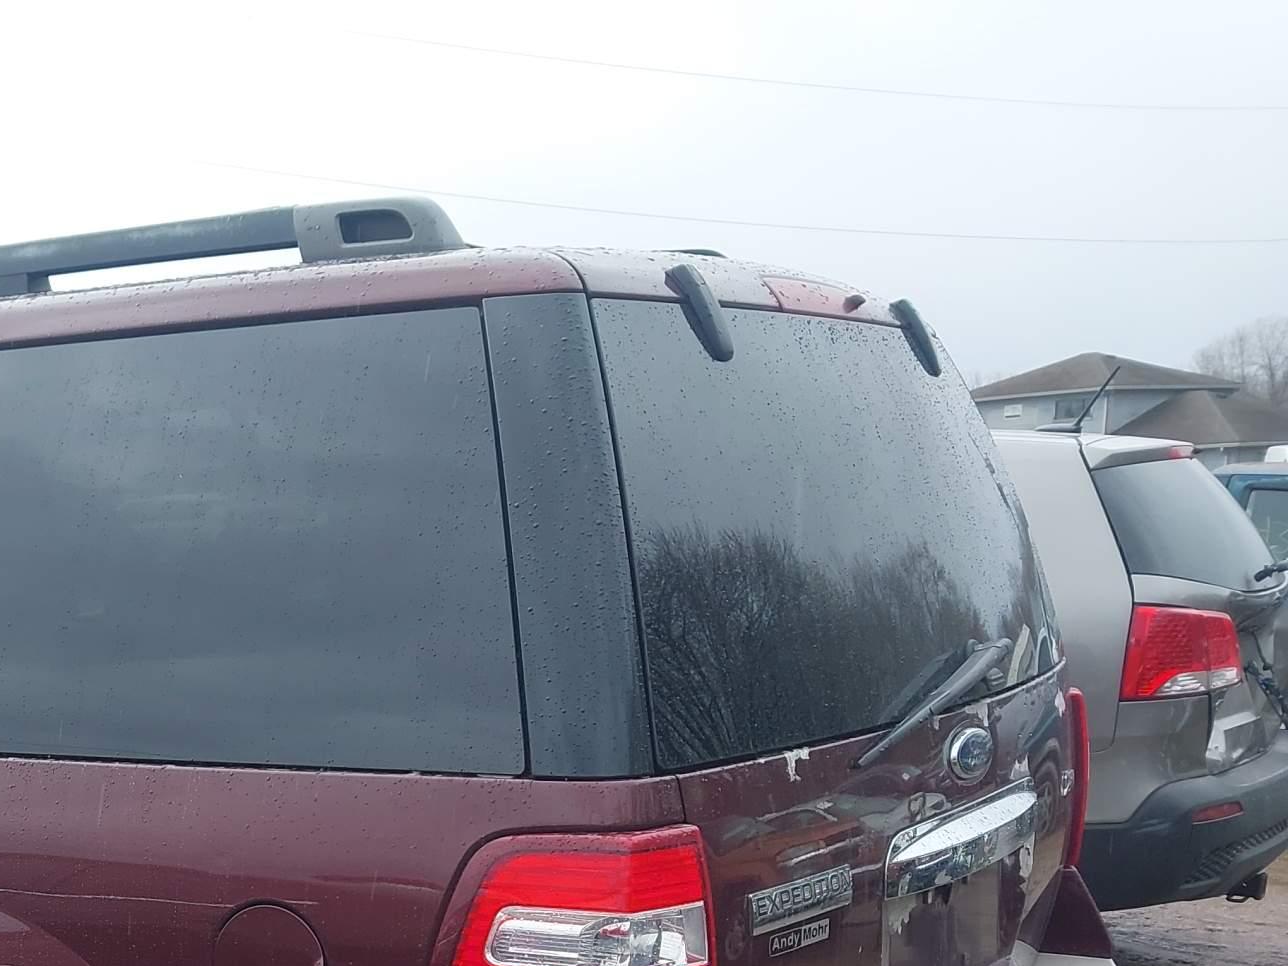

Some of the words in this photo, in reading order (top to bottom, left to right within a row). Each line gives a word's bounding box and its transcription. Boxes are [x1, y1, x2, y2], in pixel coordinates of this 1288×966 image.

[756, 868, 852, 917] EXPEDITION
[772, 934, 800, 952] Andy
[803, 924, 829, 941] Mohr
